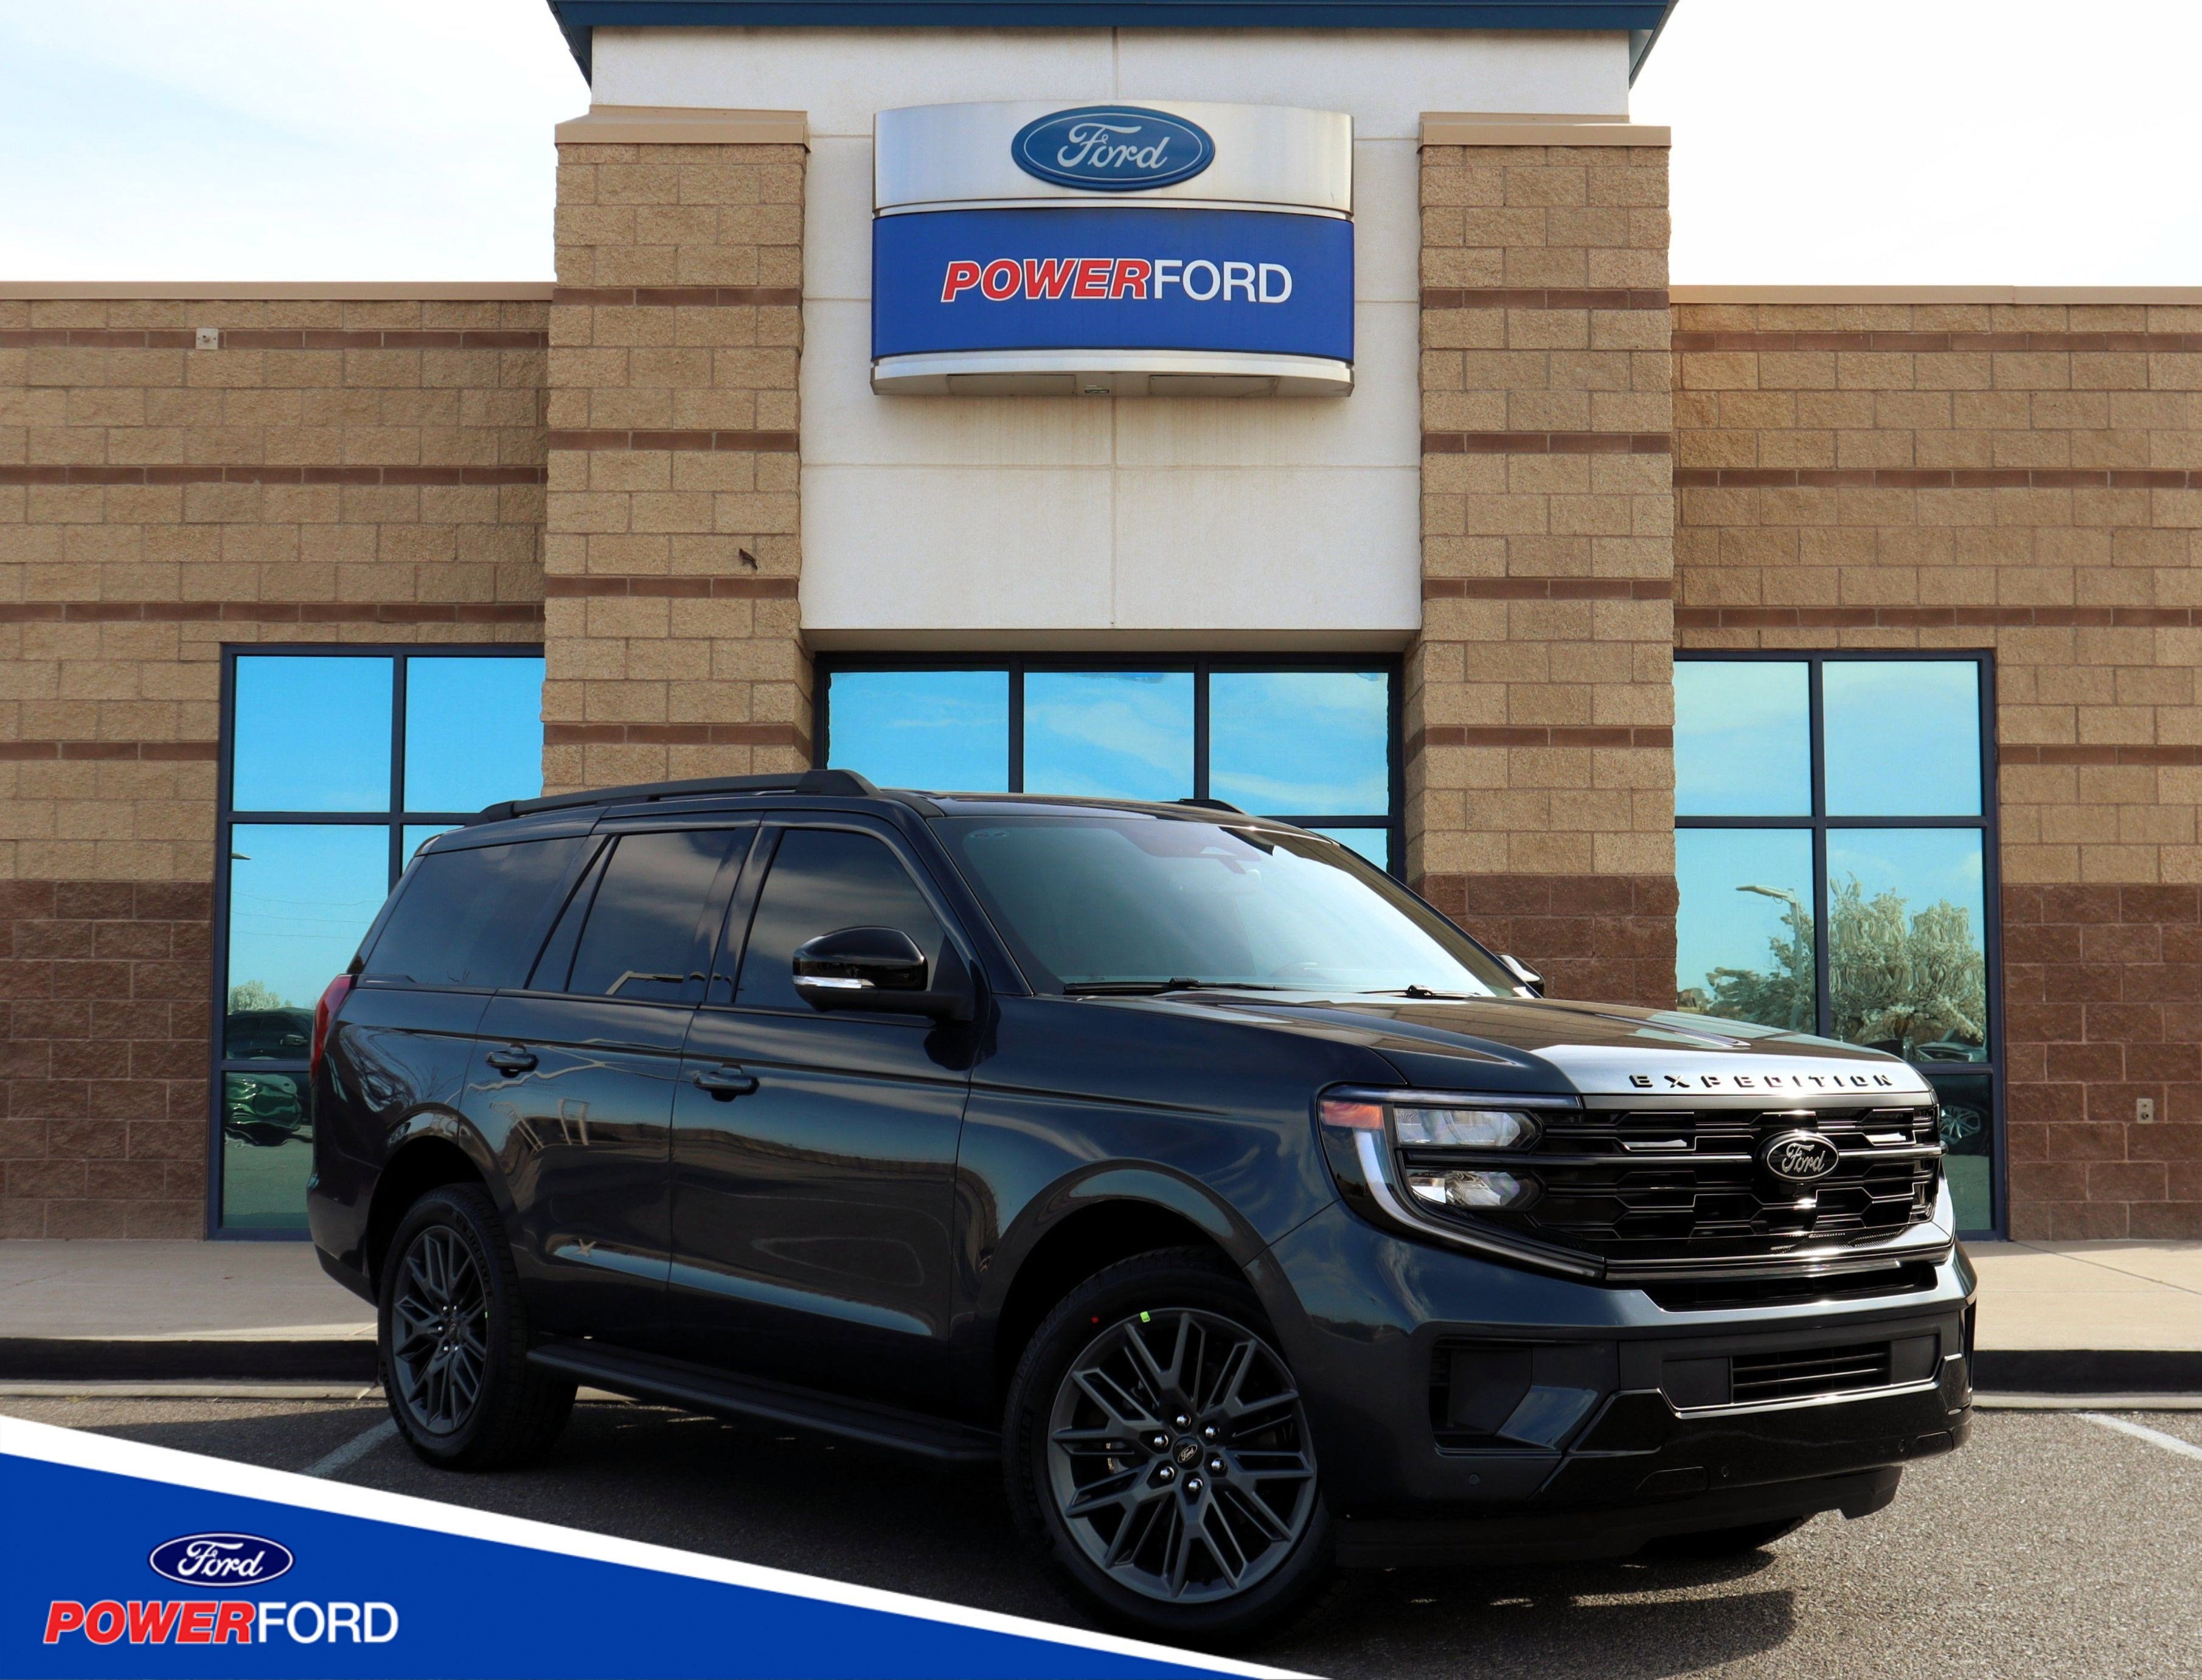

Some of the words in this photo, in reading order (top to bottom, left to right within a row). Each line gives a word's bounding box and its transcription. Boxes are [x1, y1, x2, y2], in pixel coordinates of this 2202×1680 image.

[1057, 123, 1169, 168] Ford
[1629, 1074, 1893, 1088] EXPEDITION
[1782, 1142, 1826, 1173] Ford
